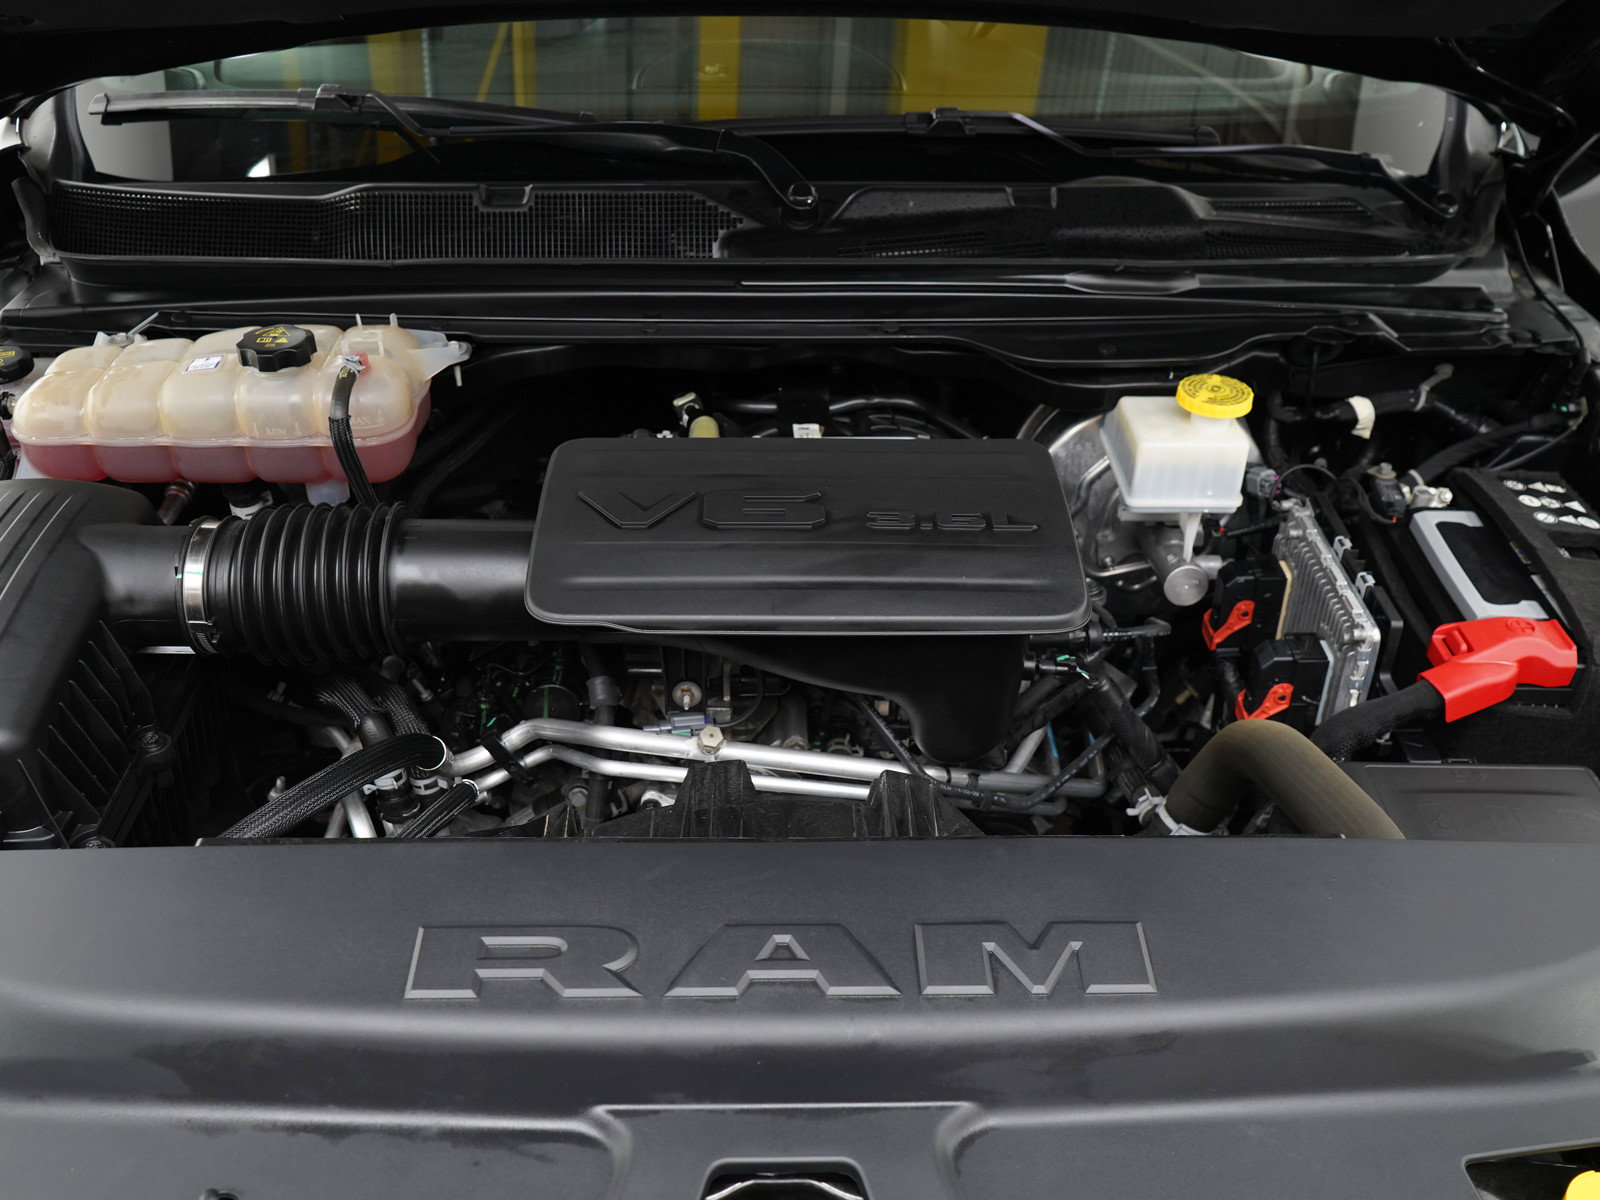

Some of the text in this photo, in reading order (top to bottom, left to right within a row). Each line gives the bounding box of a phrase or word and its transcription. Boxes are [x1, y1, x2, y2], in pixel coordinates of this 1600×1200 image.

[266, 427, 287, 437] MIN
[577, 489, 1039, 531] V6 3.6L
[404, 921, 1158, 1000] RAM
